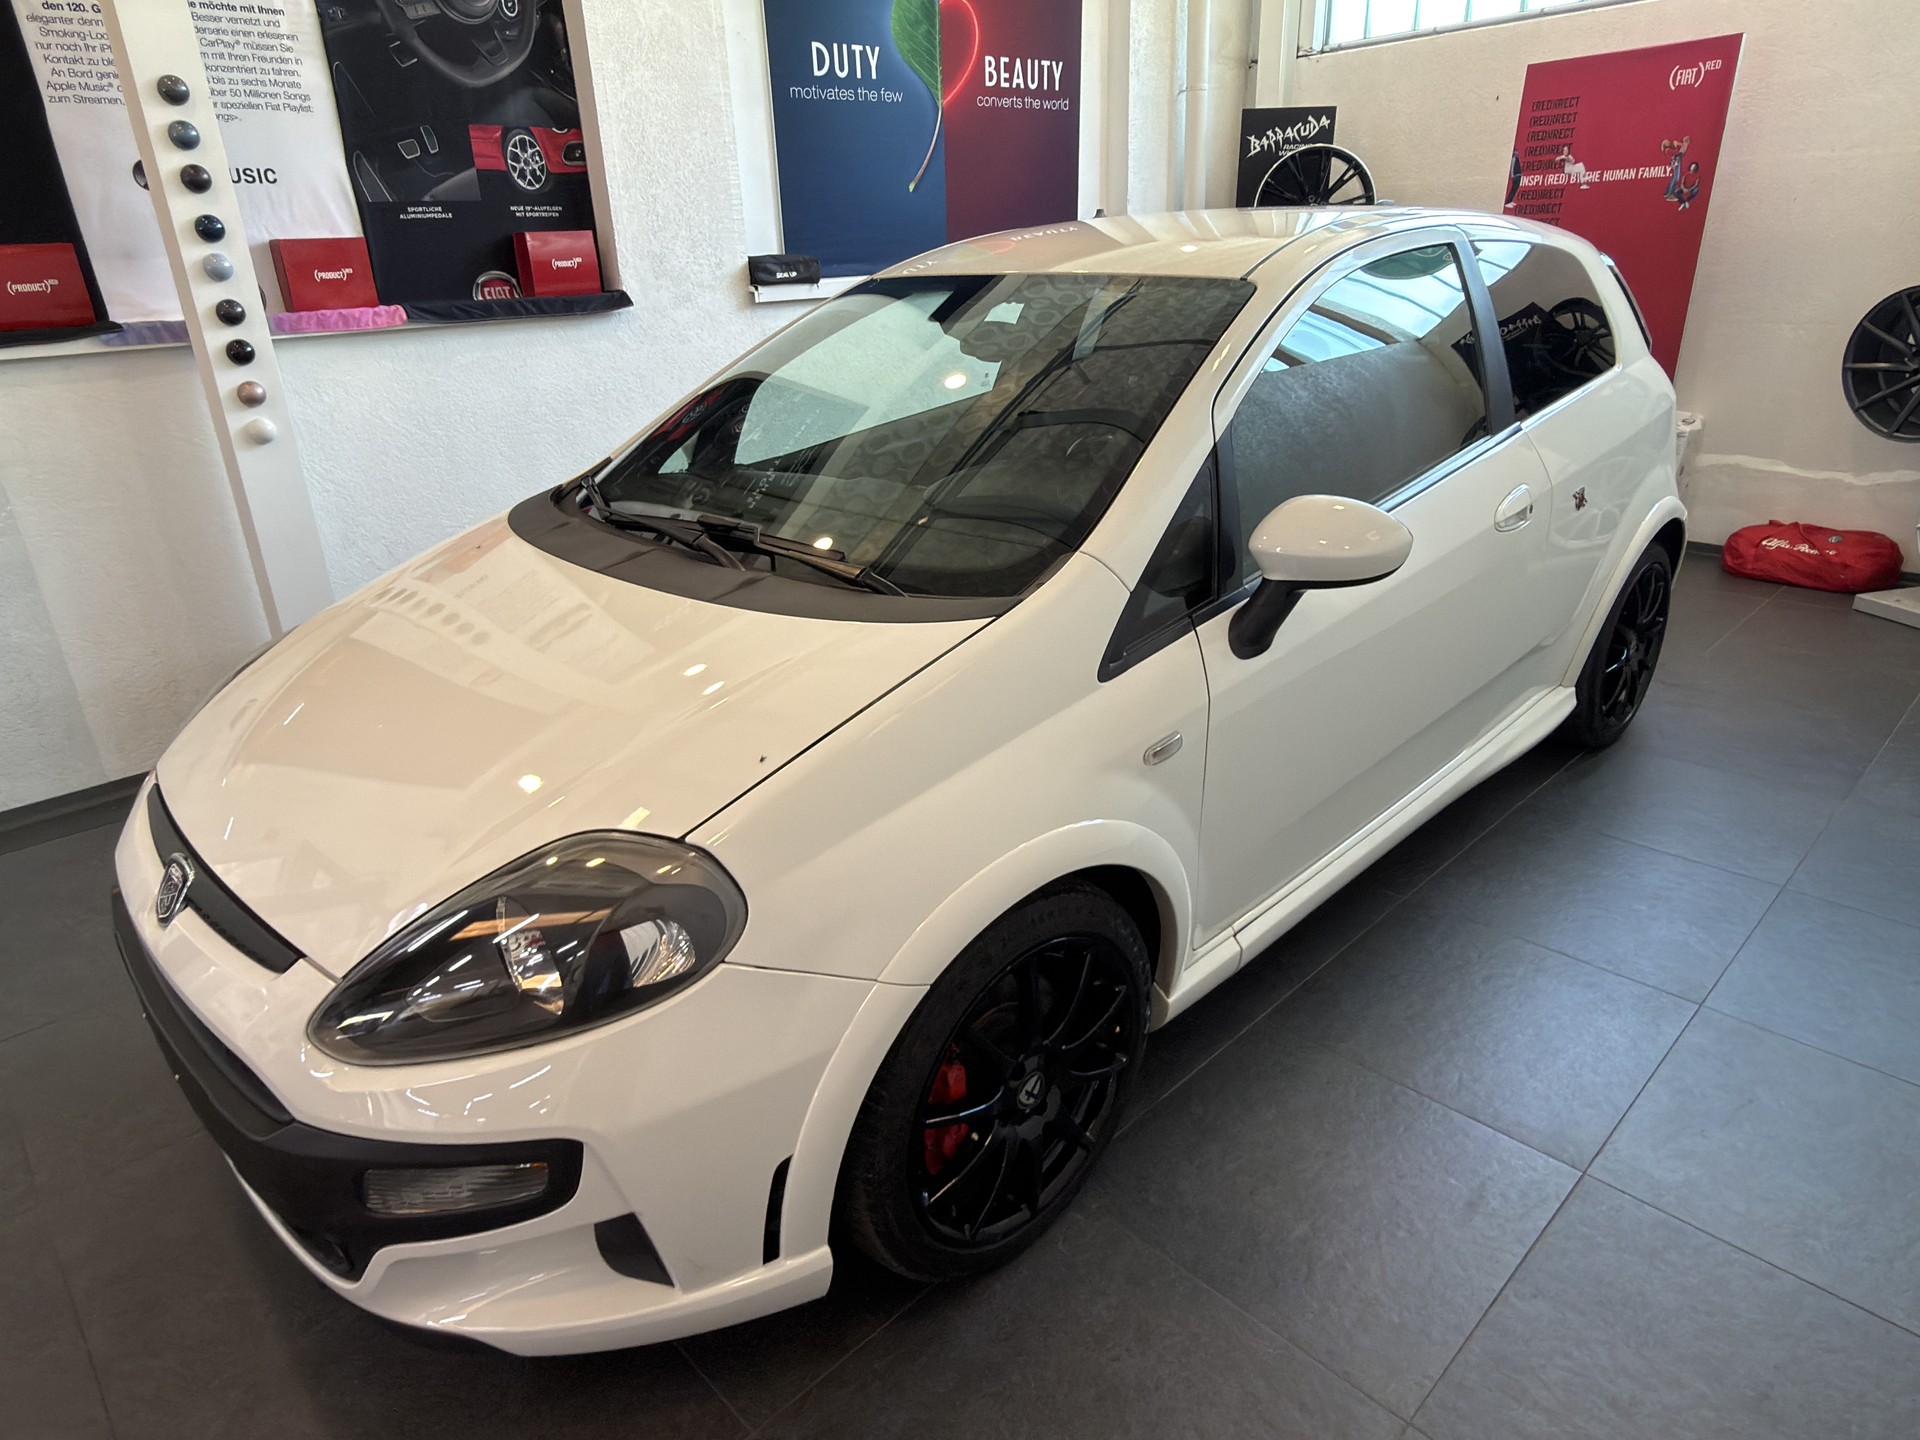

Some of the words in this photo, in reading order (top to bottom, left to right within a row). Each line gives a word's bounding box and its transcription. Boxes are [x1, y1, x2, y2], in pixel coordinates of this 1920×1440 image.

[42, 0, 64, 11] den
[66, 3, 89, 13] 120.
[198, 0, 237, 12] möchte
[239, 4, 255, 14] mit
[257, 5, 285, 16] Ihnen
[26, 13, 75, 25] eleganter
[77, 17, 104, 27] denn
[191, 11, 223, 23] Besser
[225, 16, 261, 26] vernetzt
[263, 18, 281, 28] und
[230, 28, 256, 38] einen
[257, 30, 299, 42] erlesenen
[34, 41, 52, 51] nur
[55, 43, 82, 52] noch
[83, 42, 97, 53] Ihr
[243, 41, 279, 52] müssen
[280, 43, 294, 54] Sie
[43, 53, 85, 66] Kontakt
[87, 58, 99, 66] zu
[211, 51, 226, 61] mit
[227, 51, 248, 62] Ihren
[251, 53, 292, 65] Freunden
[294, 57, 303, 66] in
[811, 41, 880, 80] DUTY
[51, 67, 66, 78] An
[67, 68, 93, 79] Bord
[204, 63, 257, 75] konzentriert
[259, 66, 271, 76] zu
[271, 67, 302, 78] fahren.
[984, 55, 1063, 91] BEAUTY
[46, 80, 76, 93] Apple
[211, 77, 226, 85] bis
[228, 78, 239, 86] zu
[241, 78, 267, 88] sechs
[268, 79, 302, 90] Monate
[48, 95, 71, 104] zum
[72, 94, 126, 106] Streamen.
[229, 88, 242, 98] 50
[243, 88, 281, 99] Millionen
[283, 91, 311, 103] Songs
[789, 85, 855, 101] motivates
[857, 86, 878, 102] the
[880, 87, 904, 103] few
[220, 101, 264, 111] speziellen
[265, 101, 281, 112] Fiat
[976, 95, 1023, 109] converts
[1024, 96, 1041, 110] the
[1042, 97, 1070, 111] world
[1246, 115, 1331, 159] BARRACUDA
[1520, 175, 1543, 187] INSPI
[1544, 173, 1568, 186] (RED)
[1603, 168, 1636, 181] HUMAN
[1638, 165, 1673, 179] FAMILY.
[483, 286, 511, 300] FIAT
